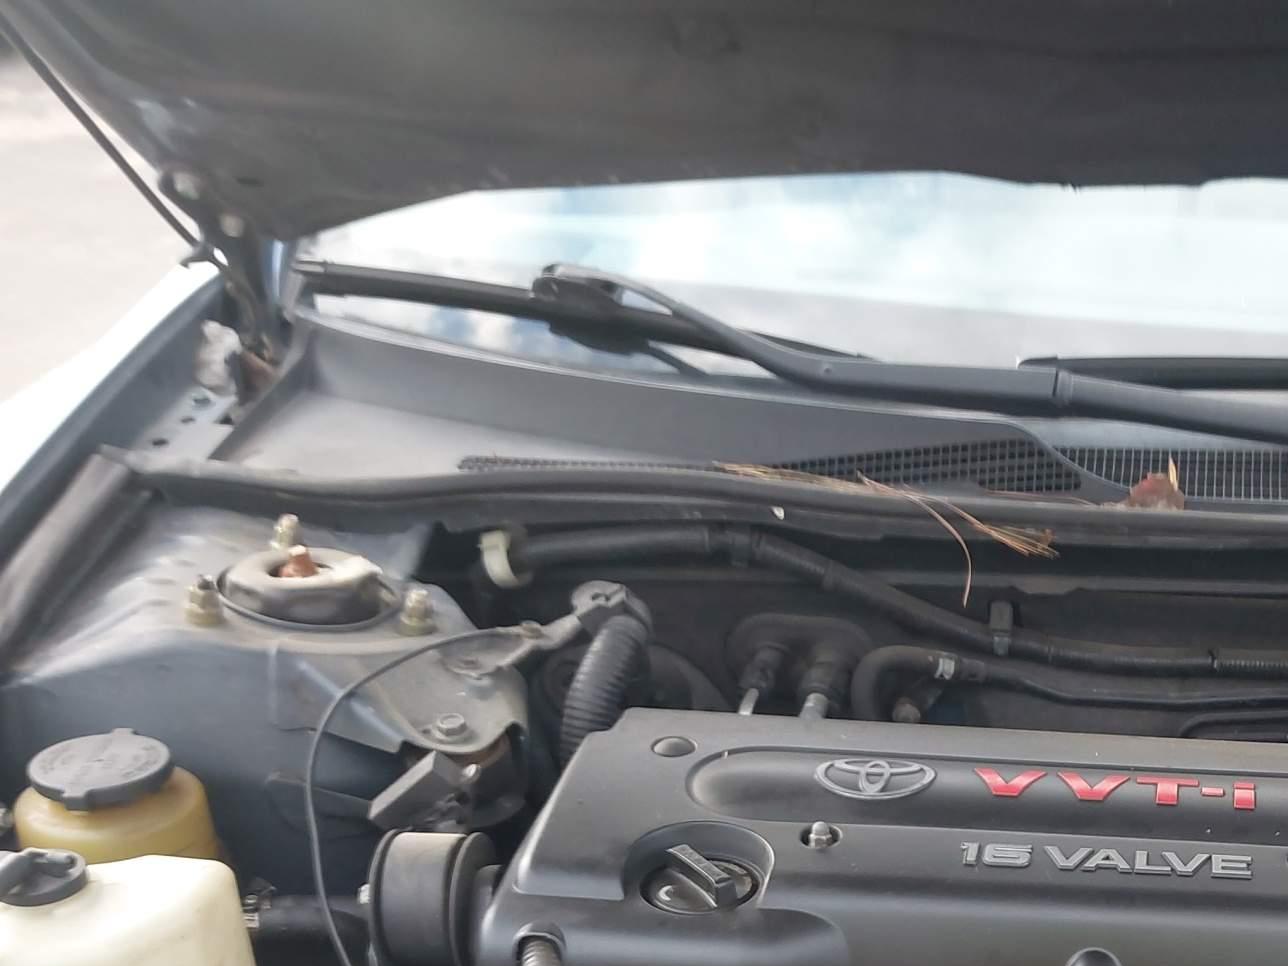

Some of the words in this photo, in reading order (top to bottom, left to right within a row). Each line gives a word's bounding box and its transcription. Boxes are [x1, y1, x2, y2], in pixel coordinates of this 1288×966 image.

[974, 767, 1256, 810] VVT-i
[960, 841, 1033, 868] 16
[1043, 845, 1253, 879] VALVE
